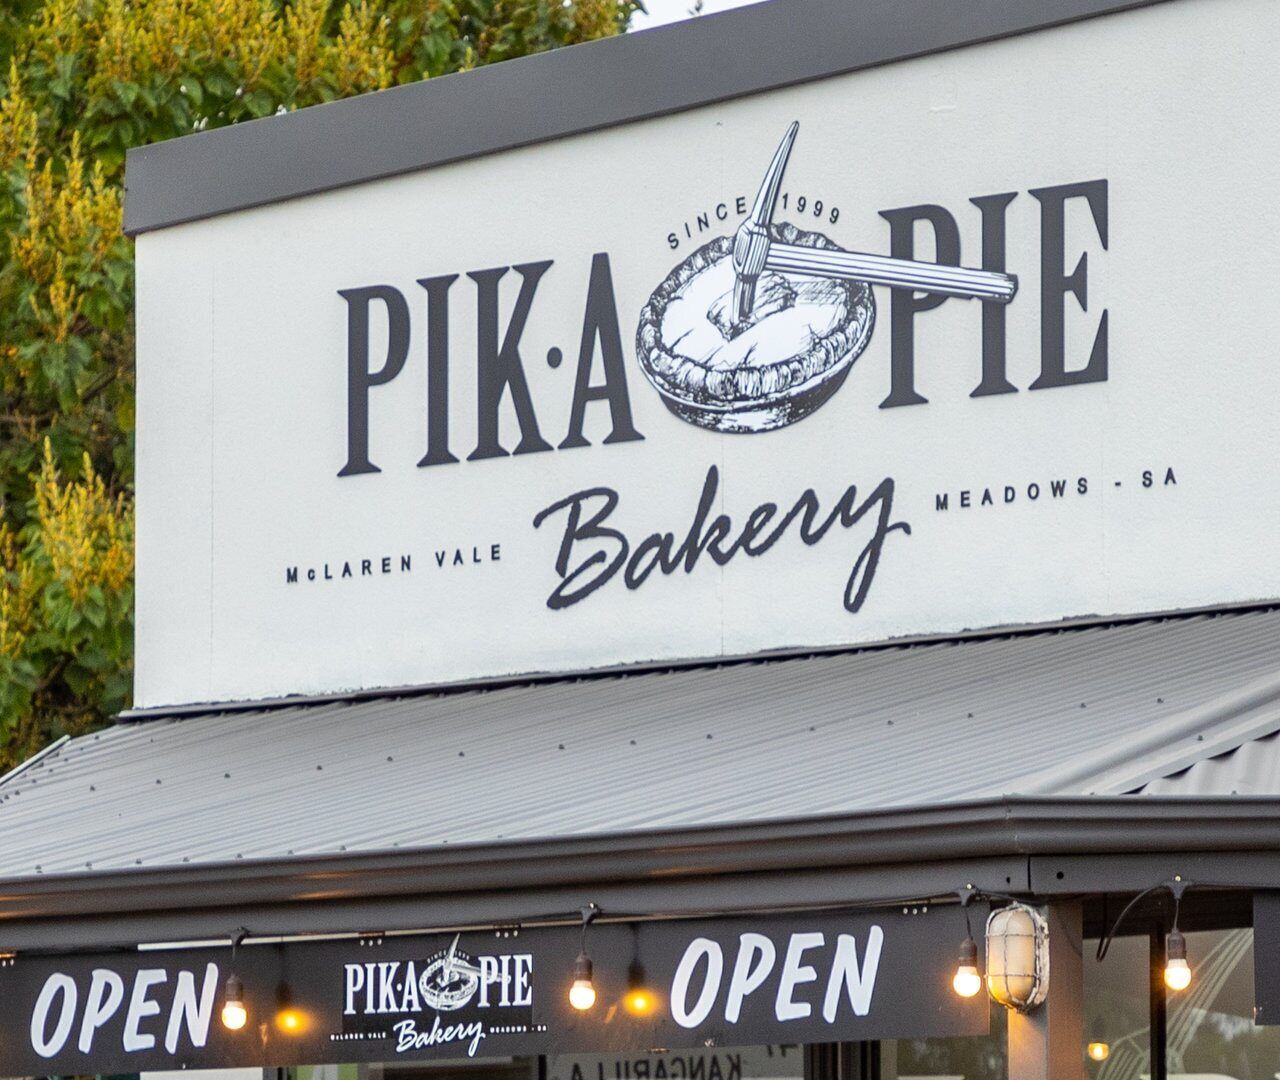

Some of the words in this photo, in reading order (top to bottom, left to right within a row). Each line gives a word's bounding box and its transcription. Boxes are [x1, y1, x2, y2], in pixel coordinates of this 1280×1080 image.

[666, 196, 750, 250] SINCE
[780, 192, 843, 225] 1999
[877, 178, 1109, 410] PIE
[935, 476, 1090, 512] MEADOWS
[1141, 467, 1179, 490] SA
[285, 554, 413, 585] McLAREN
[435, 543, 504, 567] VALE
[532, 464, 912, 613] Bakery
[477, 954, 533, 1008] PIE
[670, 924, 884, 1029] OPEN
[30, 961, 219, 1059] OPEN
[392, 1014, 487, 1057] Bakery
